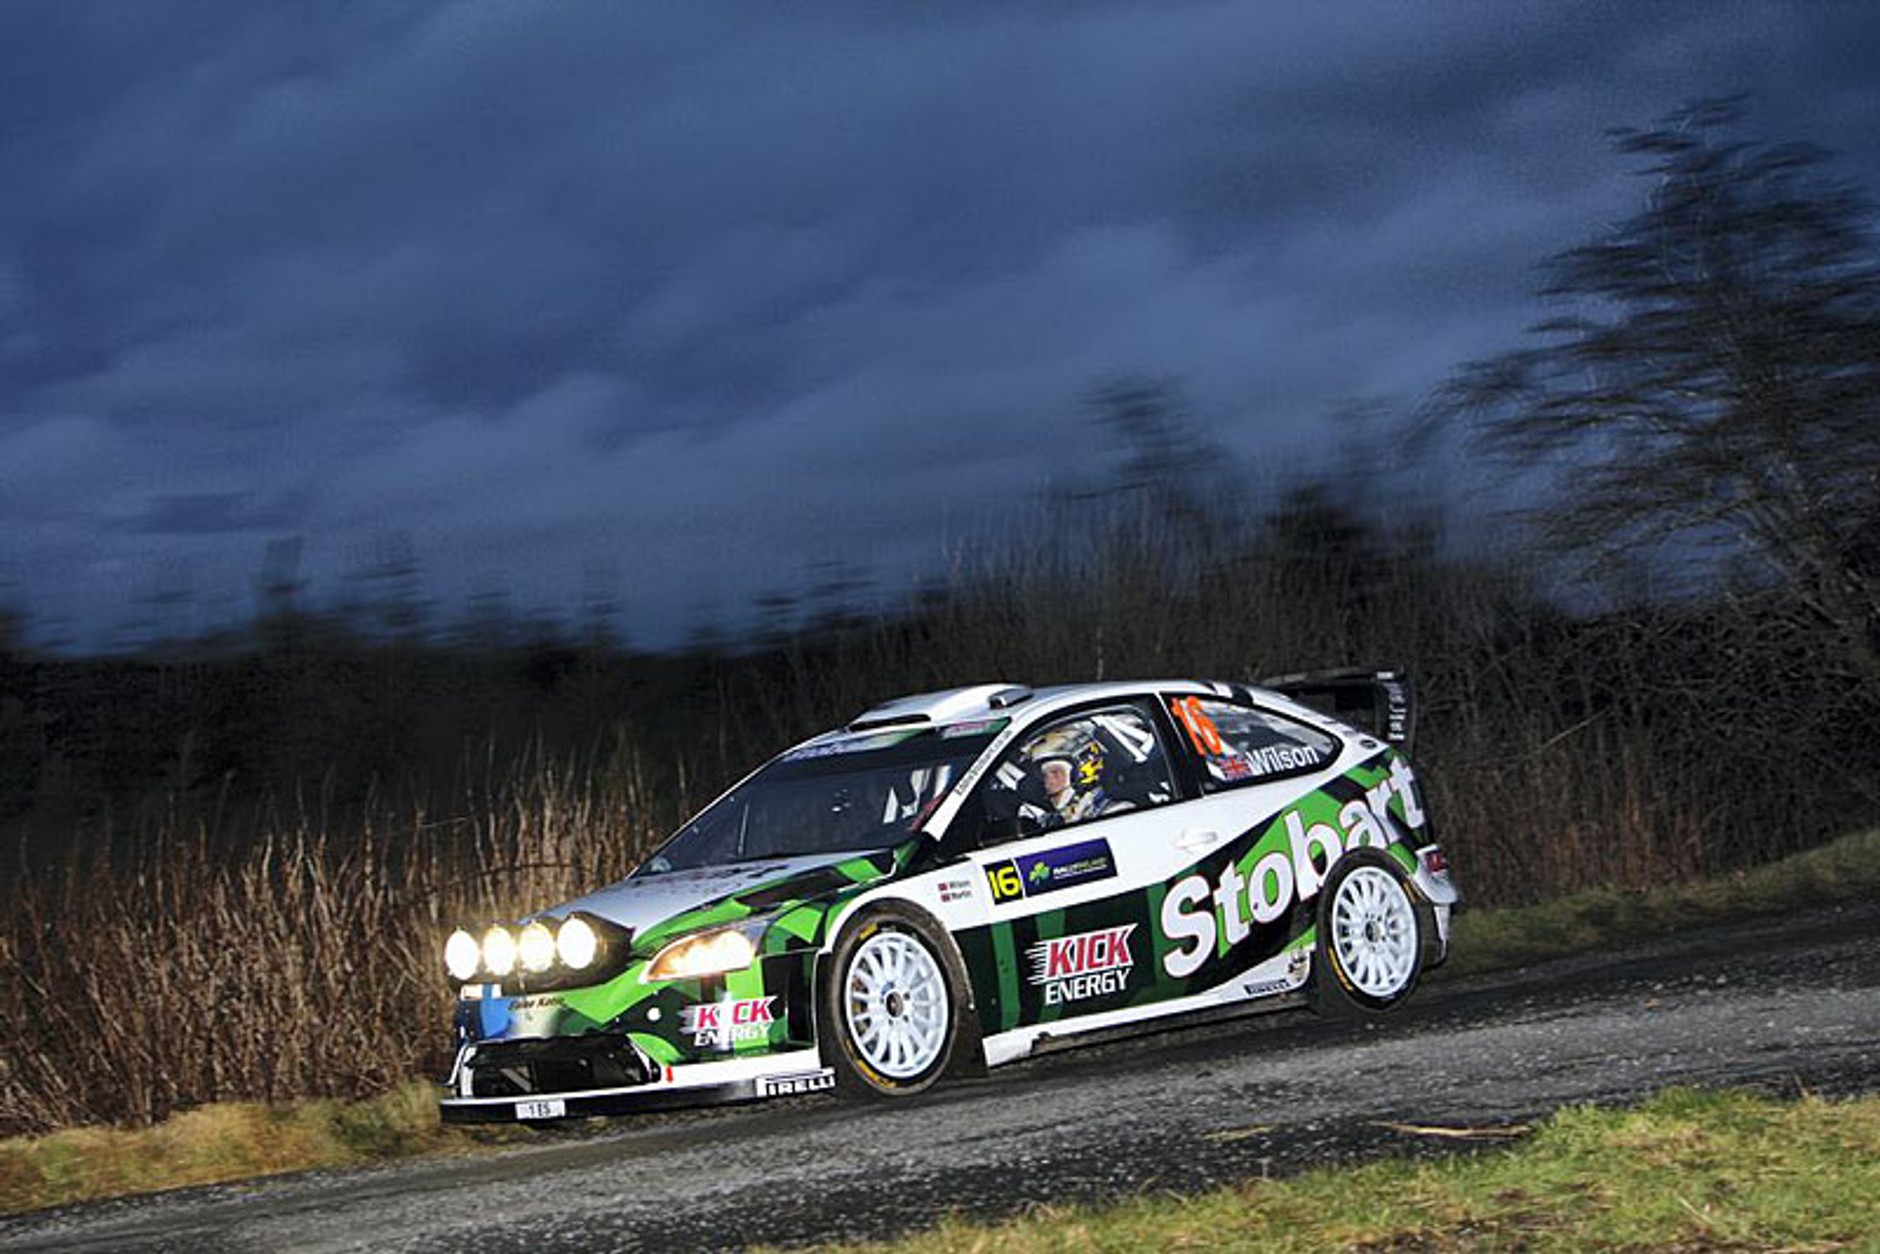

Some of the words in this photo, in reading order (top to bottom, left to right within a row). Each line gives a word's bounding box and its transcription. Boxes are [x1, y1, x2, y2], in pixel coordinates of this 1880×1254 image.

[1170, 696, 1223, 756] 16
[1246, 745, 1320, 776] Wilson
[987, 866, 1022, 899] 16
[1161, 755, 1424, 977] Stobart
[1045, 926, 1133, 978] KICK
[1044, 967, 1131, 1006] ENERGY
[696, 997, 771, 1029] KCK
[694, 1023, 770, 1047] ENRGY
[755, 1067, 836, 1097] PIRELLI
